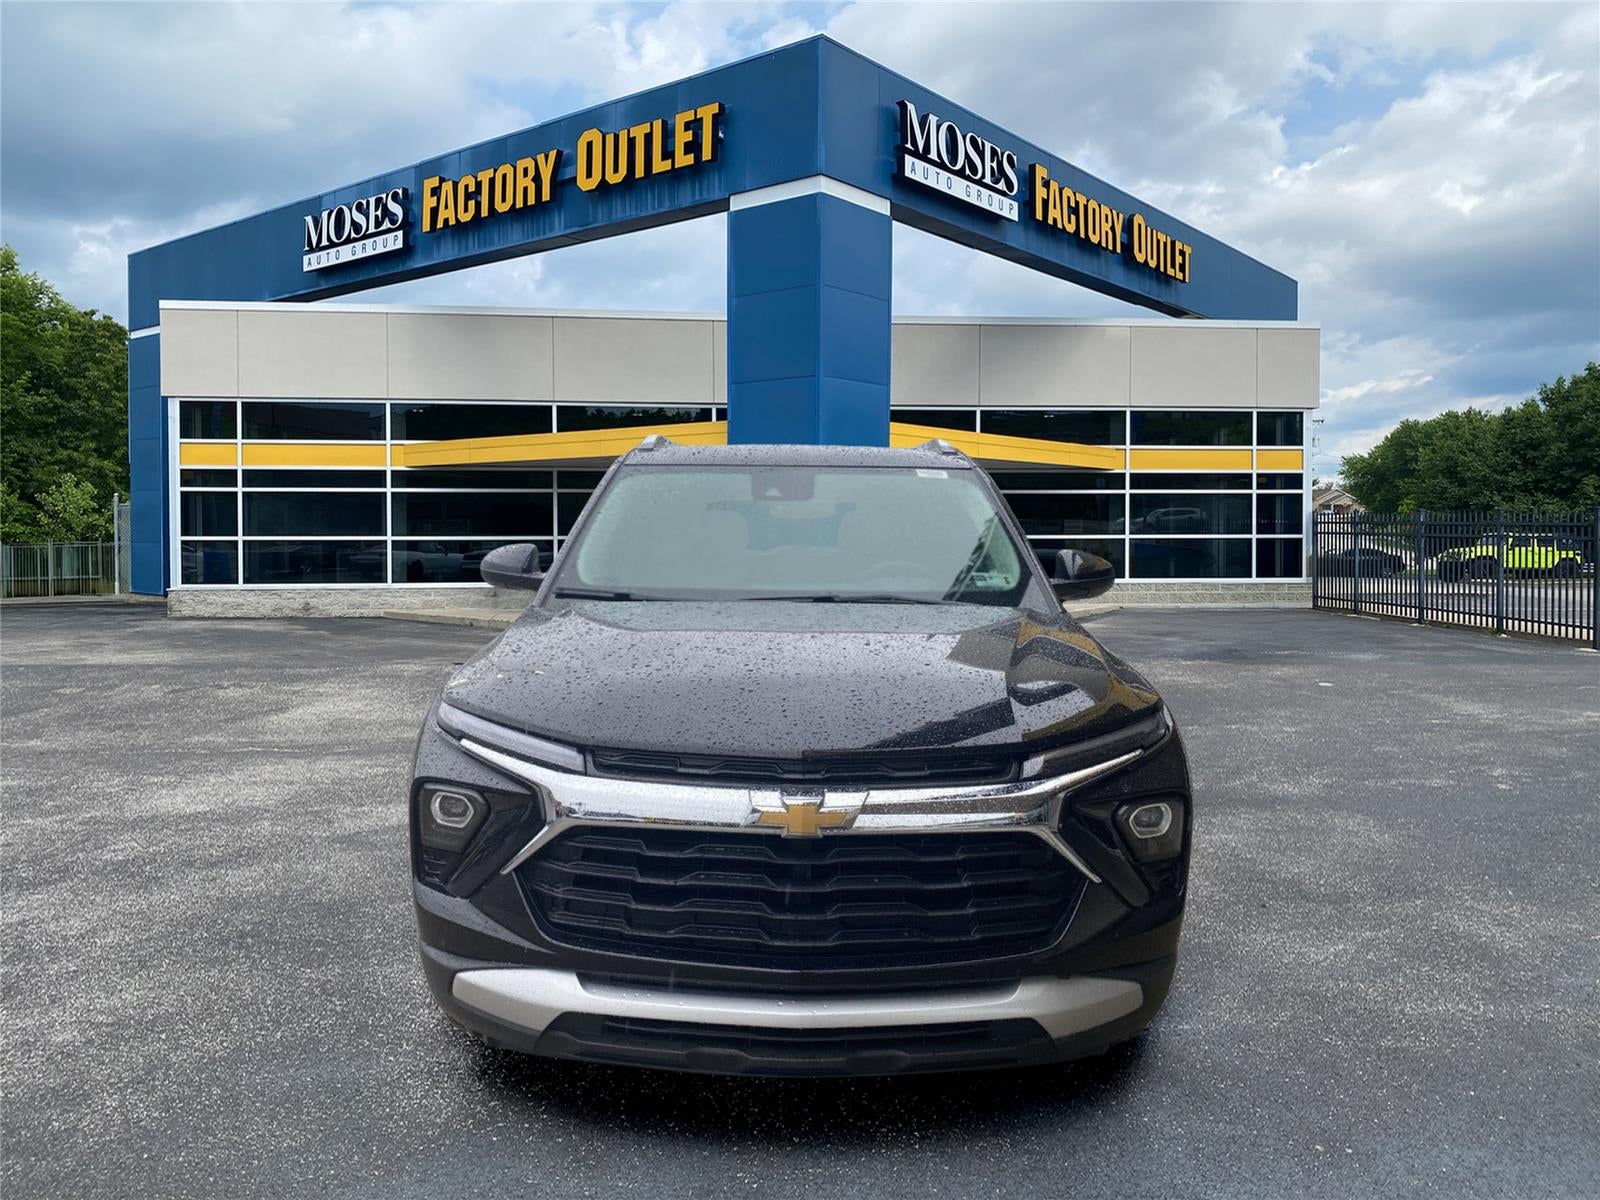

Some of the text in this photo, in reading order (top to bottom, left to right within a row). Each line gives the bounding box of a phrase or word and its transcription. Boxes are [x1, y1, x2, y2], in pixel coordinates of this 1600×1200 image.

[422, 102, 720, 232] FACTORY OUTLET
[904, 100, 1018, 196] MOSES
[910, 161, 1014, 214] AUTO GROUP
[303, 187, 403, 251] MOSES
[307, 234, 399, 268] AUTO GROUP
[1035, 163, 1192, 283] FACTORY OUTLET
